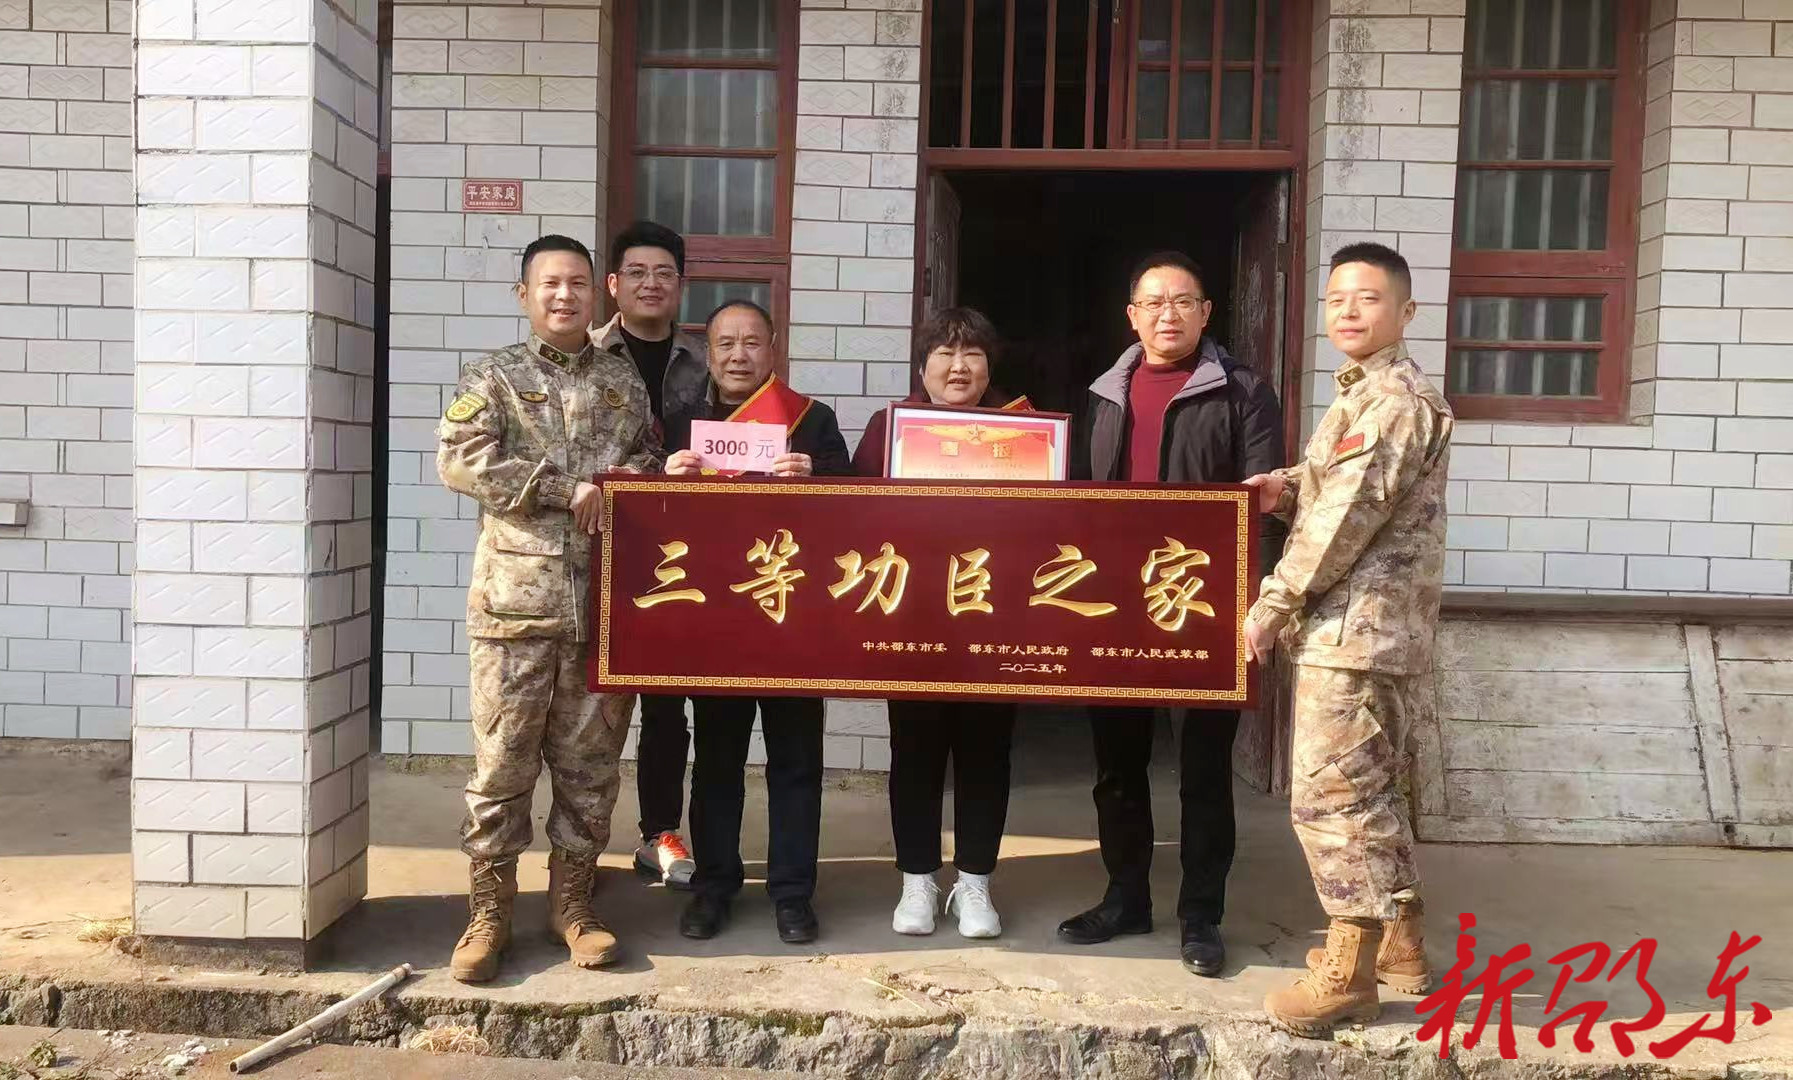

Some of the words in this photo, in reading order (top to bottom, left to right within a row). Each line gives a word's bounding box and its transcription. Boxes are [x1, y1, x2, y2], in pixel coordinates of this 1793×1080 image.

[466, 185, 516, 201] 平安家庭
[704, 439, 749, 456] 3000
[754, 439, 776, 459] 元
[631, 528, 1217, 633] 三等功臣之家
[861, 640, 948, 654] 中共邵东市委
[967, 643, 1070, 657] 邵东市人民政府
[1089, 646, 1210, 661] 邵东市人民武装部
